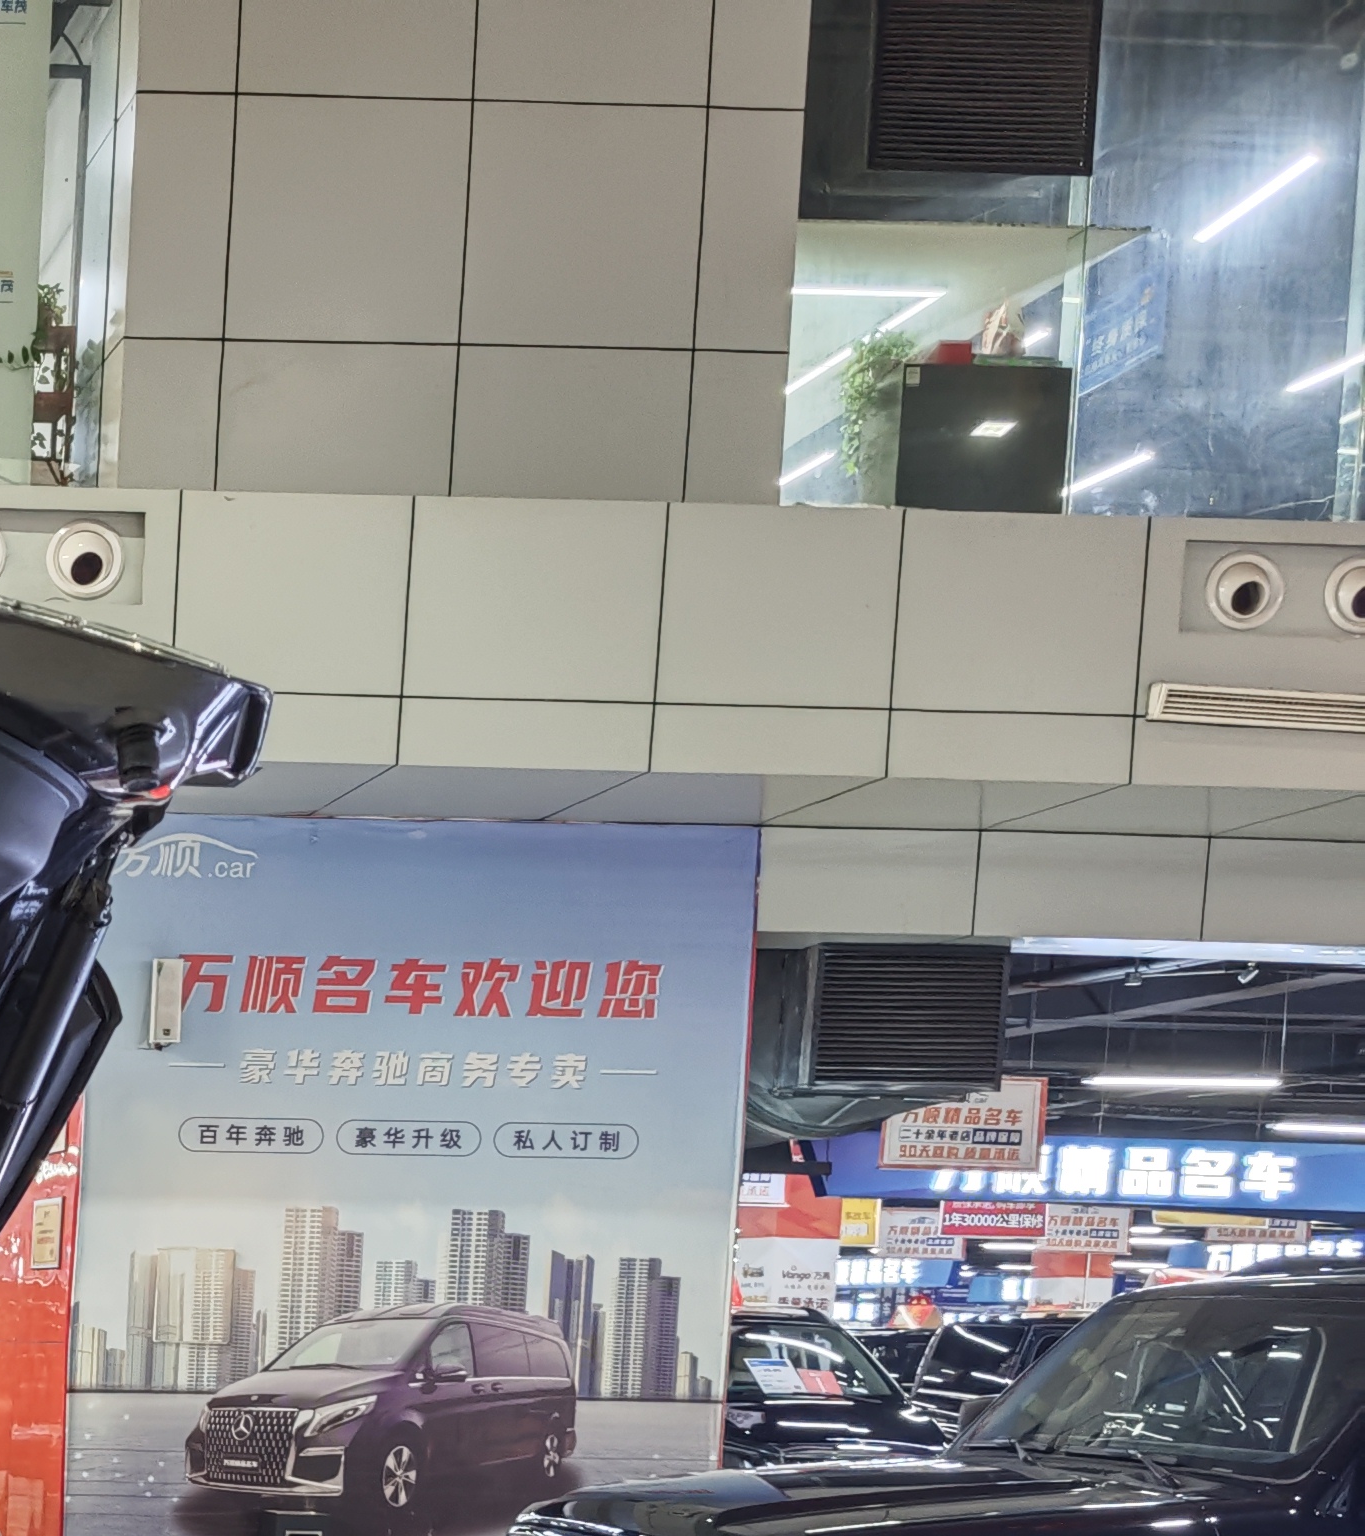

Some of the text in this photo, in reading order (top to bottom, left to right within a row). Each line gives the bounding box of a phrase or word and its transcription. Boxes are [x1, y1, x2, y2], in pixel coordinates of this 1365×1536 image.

[178, 952, 666, 1020] 万顺名车欢迎您
[238, 1047, 590, 1090] 豪华奔驰商务专卖
[901, 1106, 1023, 1127] 万顺精品名车
[196, 1122, 622, 1154] 百年奔驰 豪华升级 私人订制
[943, 1212, 1044, 1228] 1年30000公里保修
